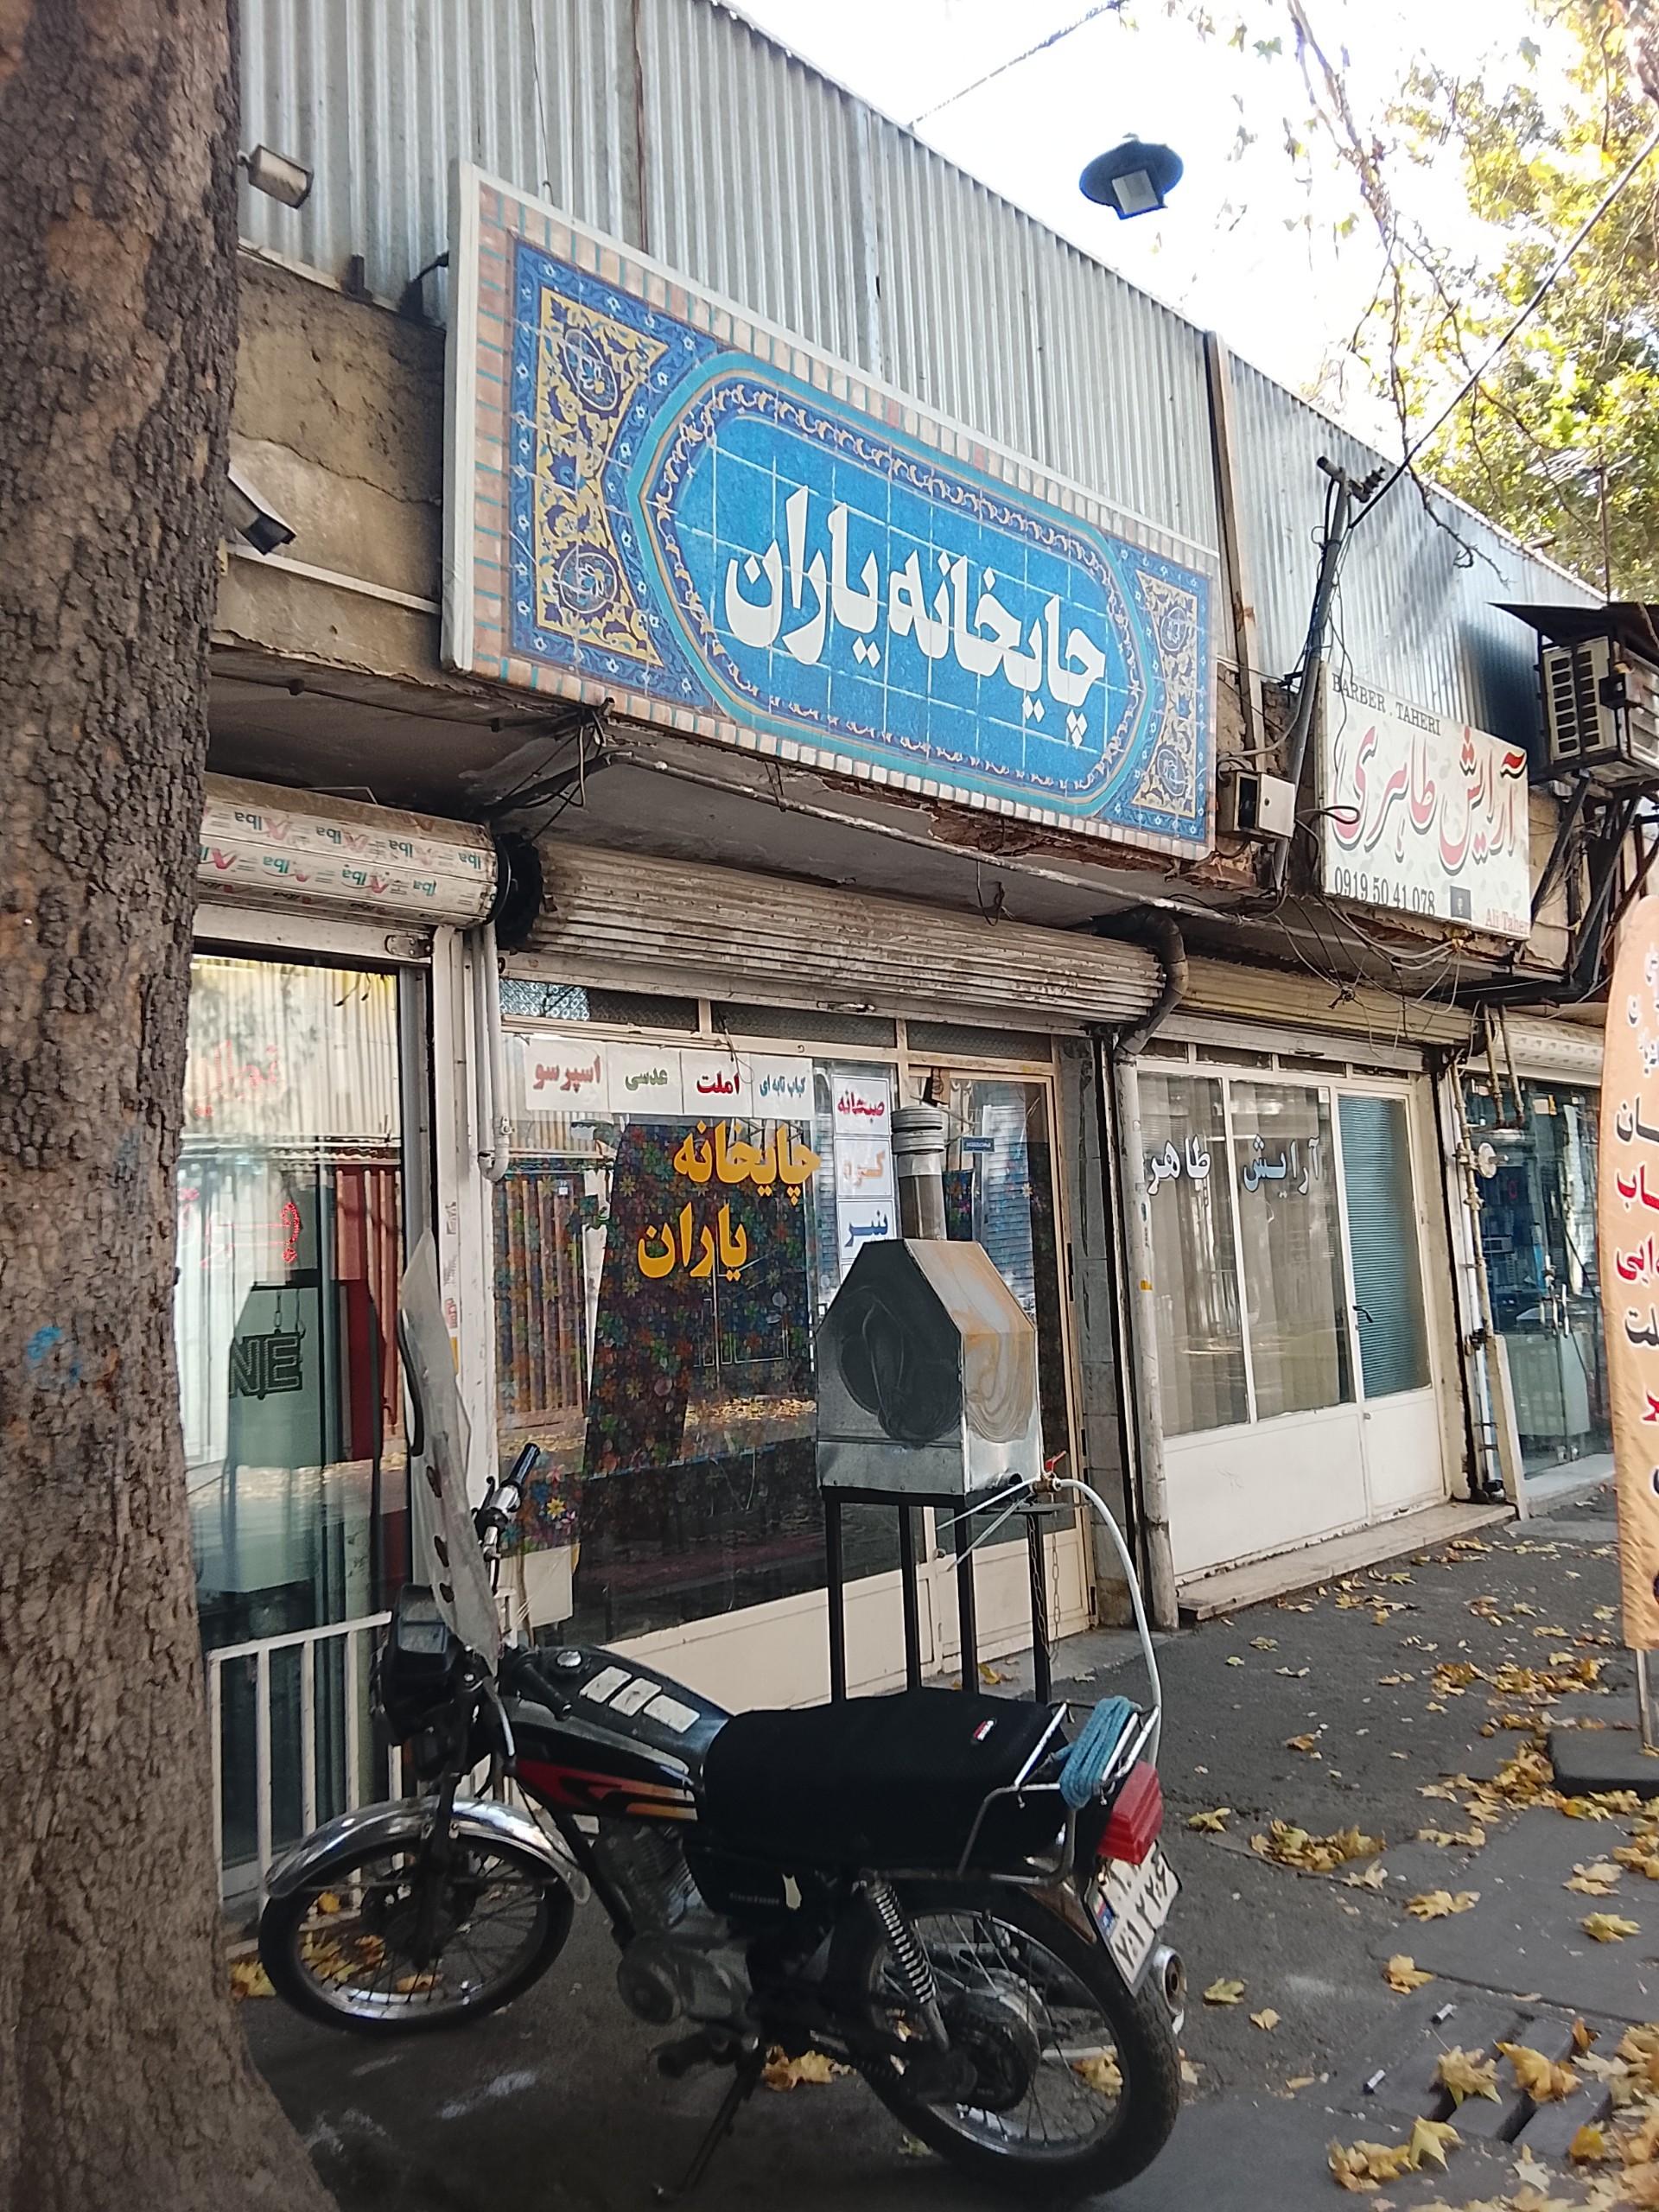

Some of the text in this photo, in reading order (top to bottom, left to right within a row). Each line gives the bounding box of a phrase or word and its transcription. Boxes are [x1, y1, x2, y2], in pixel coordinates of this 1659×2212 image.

[725, 486, 1106, 749] چایخانه یاران
[1332, 673, 1441, 736] BARBER TAHERI
[1332, 726, 1526, 873] آرایش طاهری
[1335, 867, 1436, 916] 0919 50 41 078
[626, 1067, 668, 1091] عدسی
[696, 1071, 740, 1096] املت
[787, 1076, 805, 1098] کباب
[673, 1120, 821, 1206] چایخانه
[1147, 1134, 1319, 1198] آرایش طاهر
[638, 1201, 747, 1281] یاران
